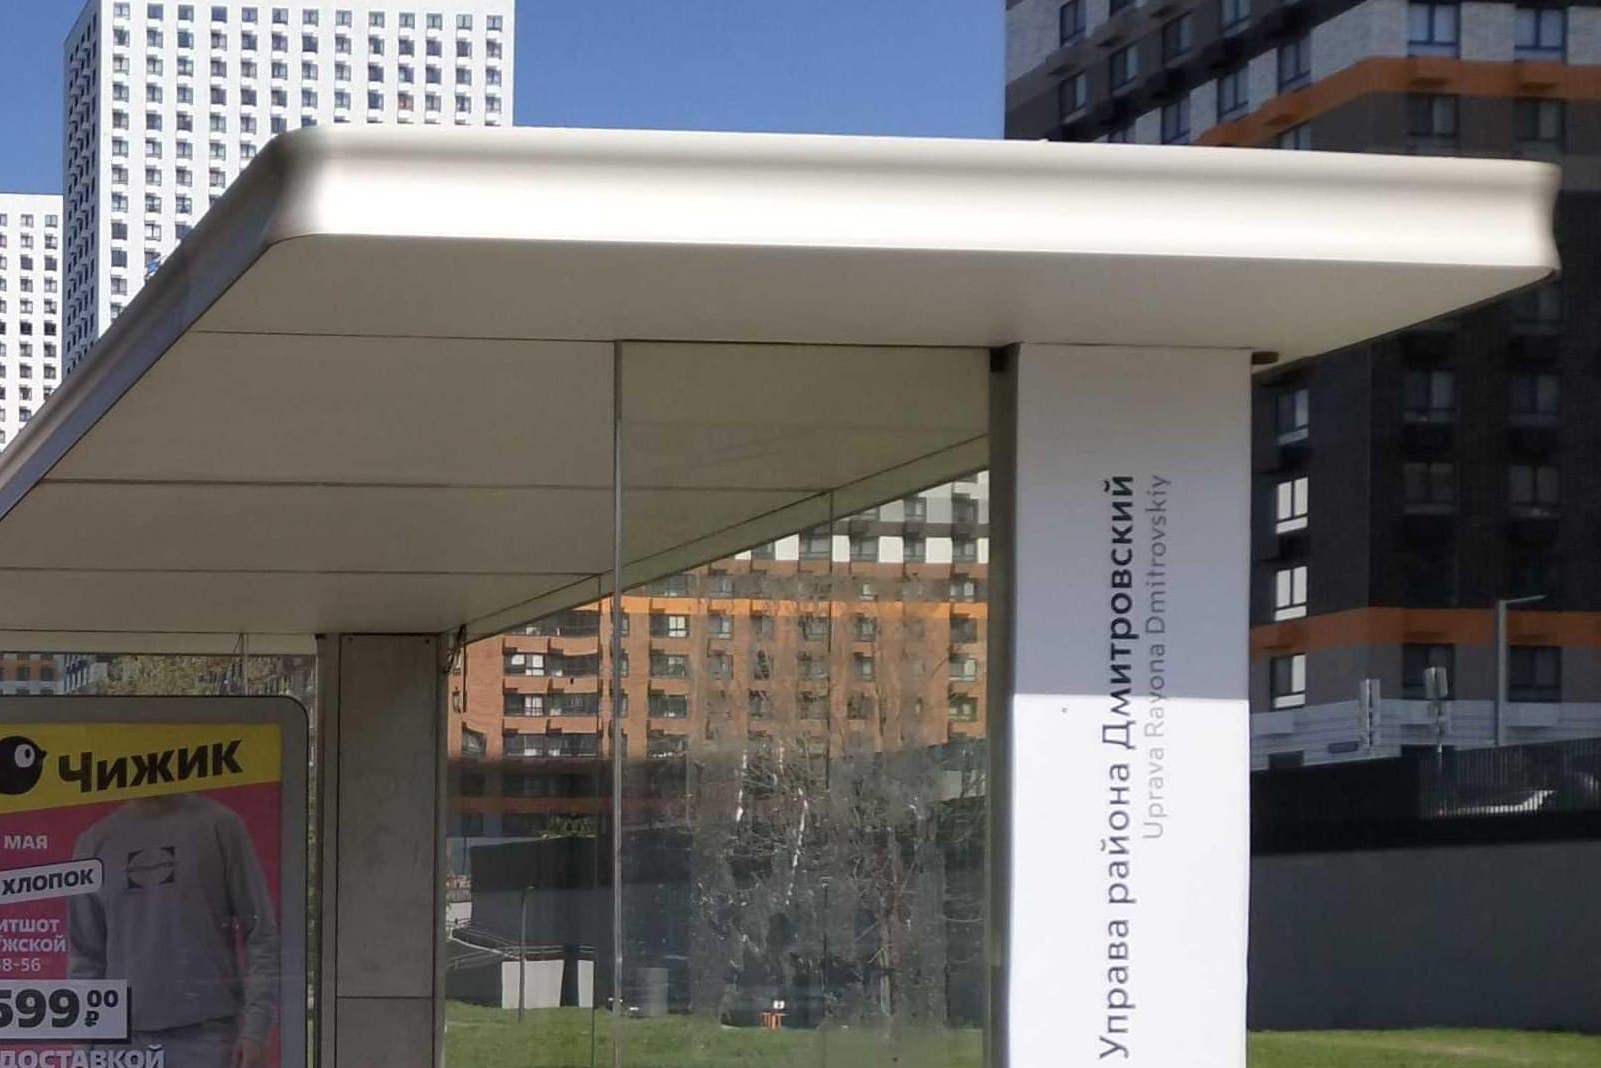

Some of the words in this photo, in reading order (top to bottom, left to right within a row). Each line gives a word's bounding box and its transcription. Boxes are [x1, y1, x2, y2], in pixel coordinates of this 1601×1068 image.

[1101, 475, 1140, 751] Дмитровский
[1145, 474, 1172, 635] Dmitrovskiy
[1144, 644, 1168, 739] Rayona
[3, 834, 48, 851] МАЯ
[1100, 763, 1137, 904] района
[1143, 748, 1168, 840] Uprava
[1, 867, 96, 896] ХЛОПОК
[1099, 918, 1136, 1060] Управа
